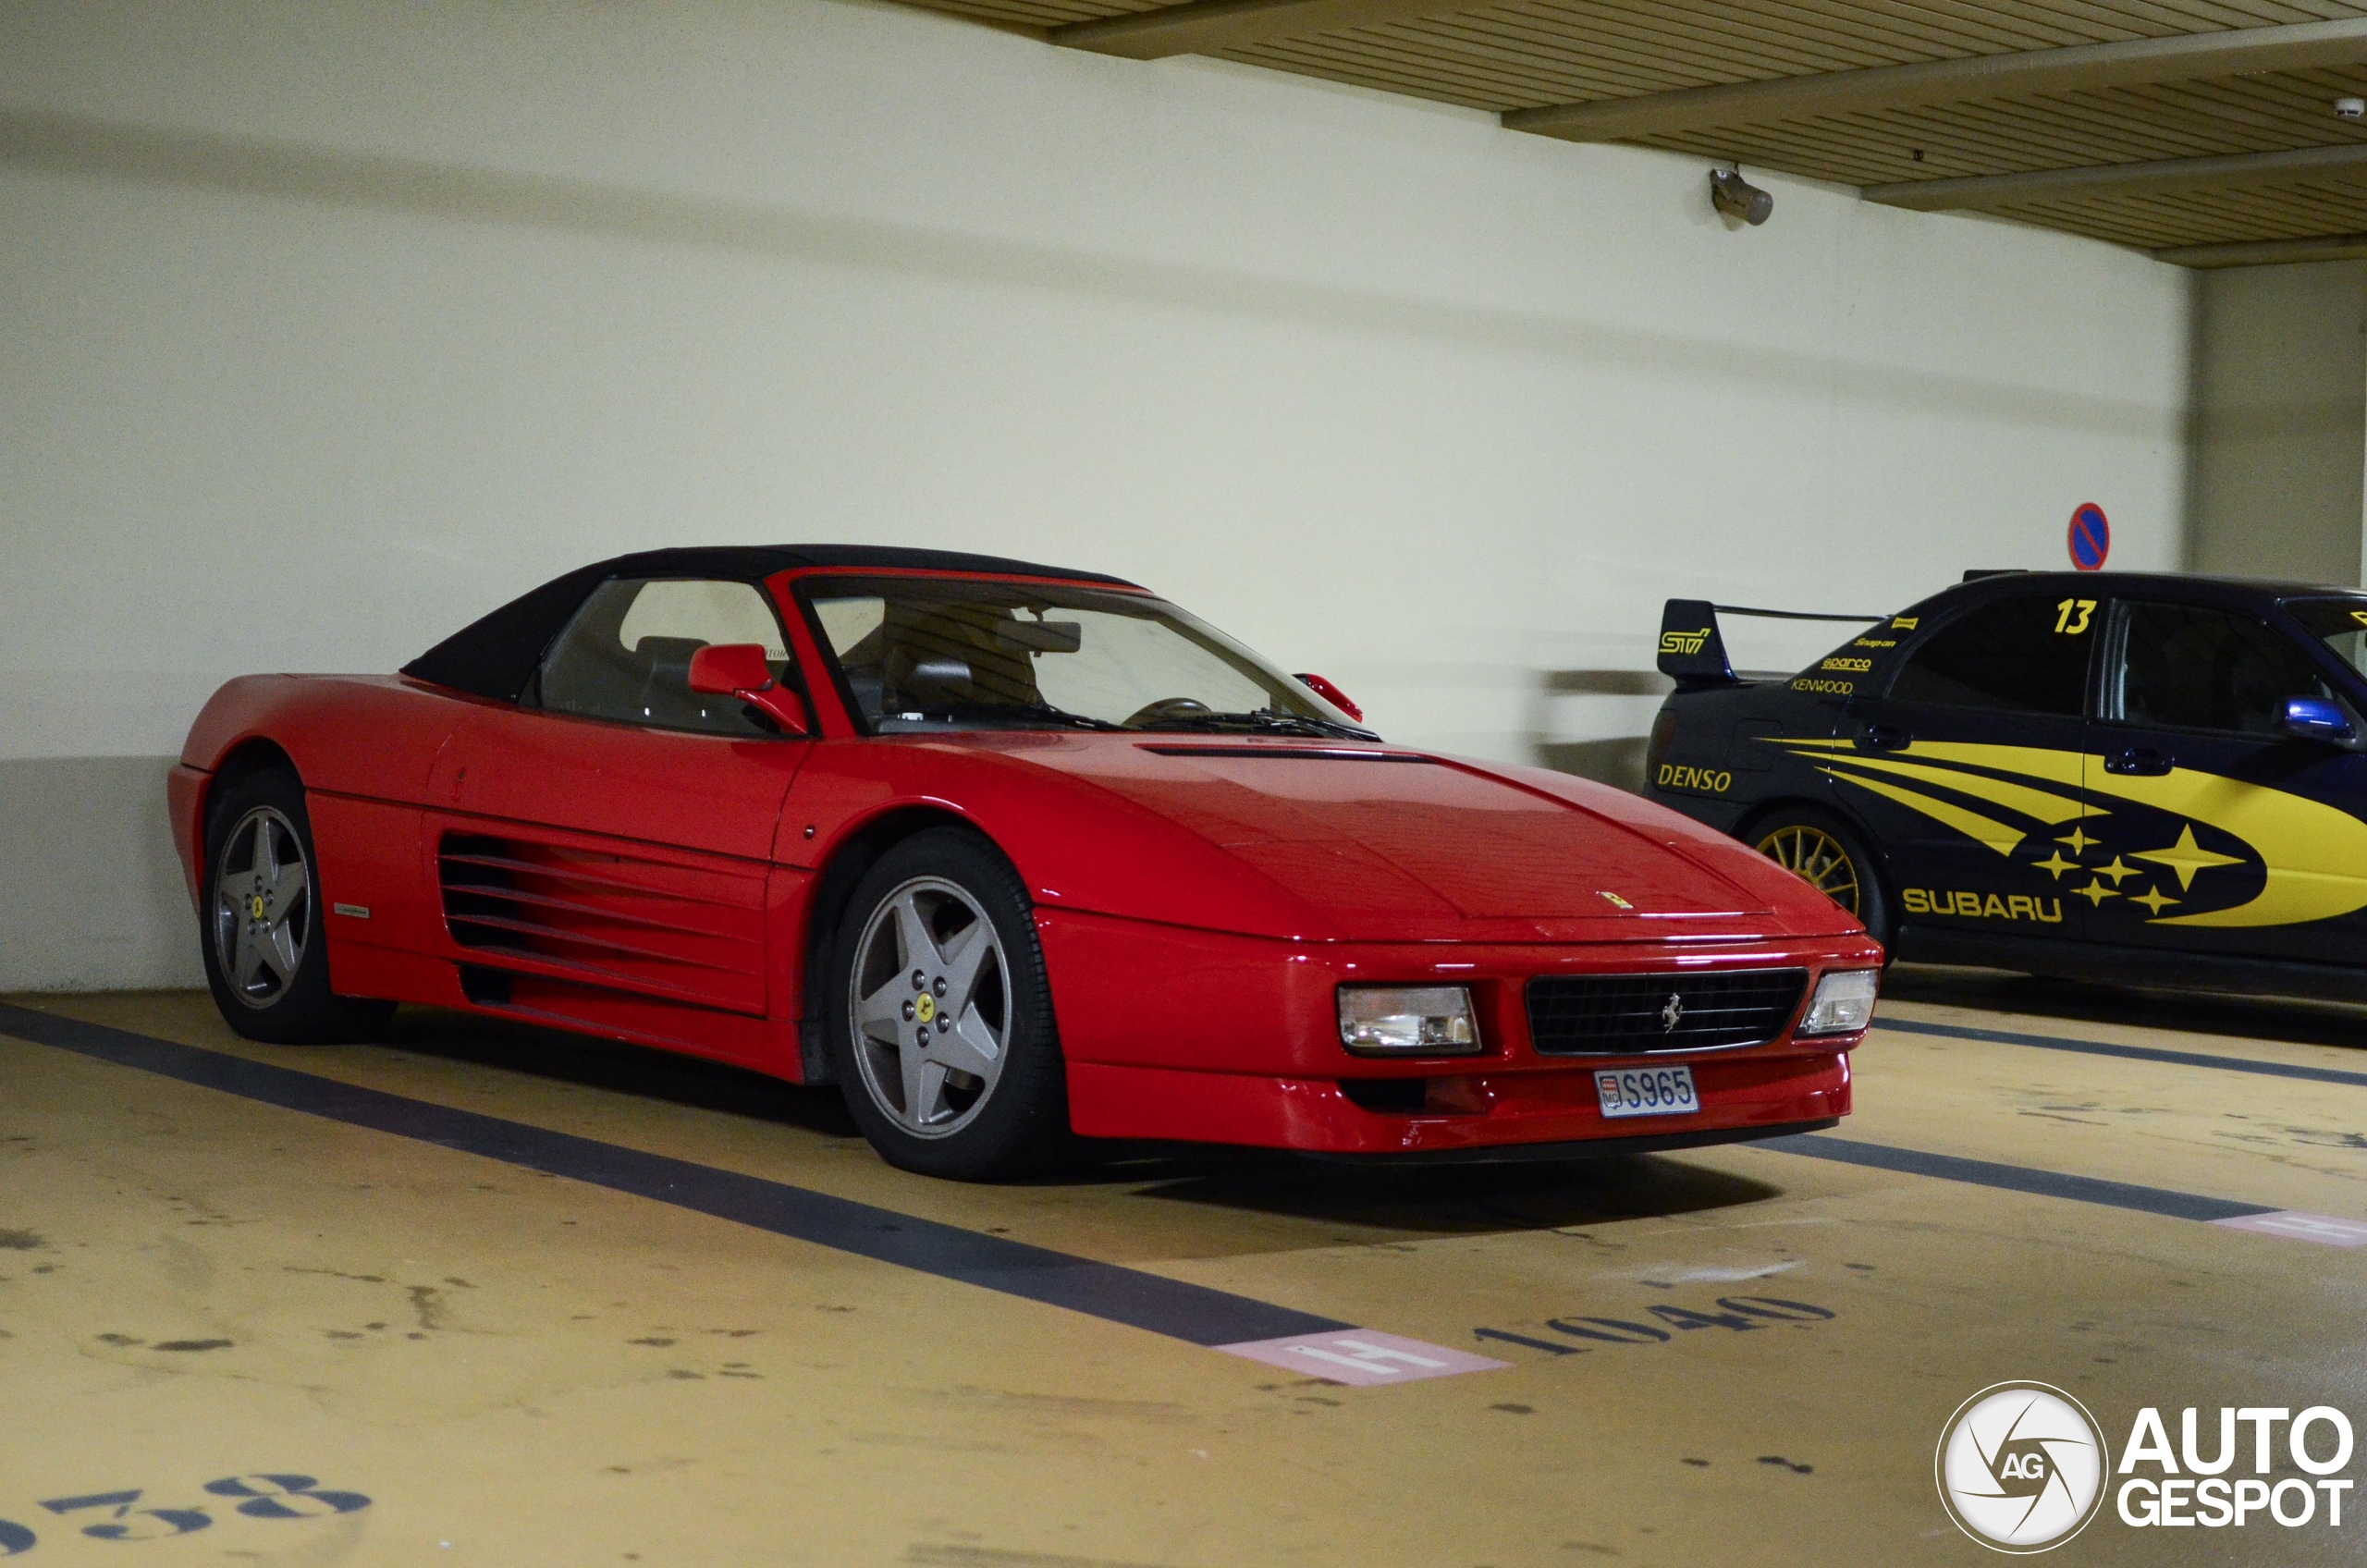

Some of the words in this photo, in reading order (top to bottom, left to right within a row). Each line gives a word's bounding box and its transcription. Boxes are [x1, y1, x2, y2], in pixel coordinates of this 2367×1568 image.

[2054, 598, 2097, 634] 13
[1821, 657, 1872, 671] sparco
[1791, 679, 1853, 694] KENWOOD
[1658, 764, 1732, 792] DENSO
[1902, 888, 2063, 923] SUBARU
[1602, 1092, 1619, 1104] MC
[1623, 1071, 1692, 1109] S965
[1473, 1295, 1836, 1356] 1040
